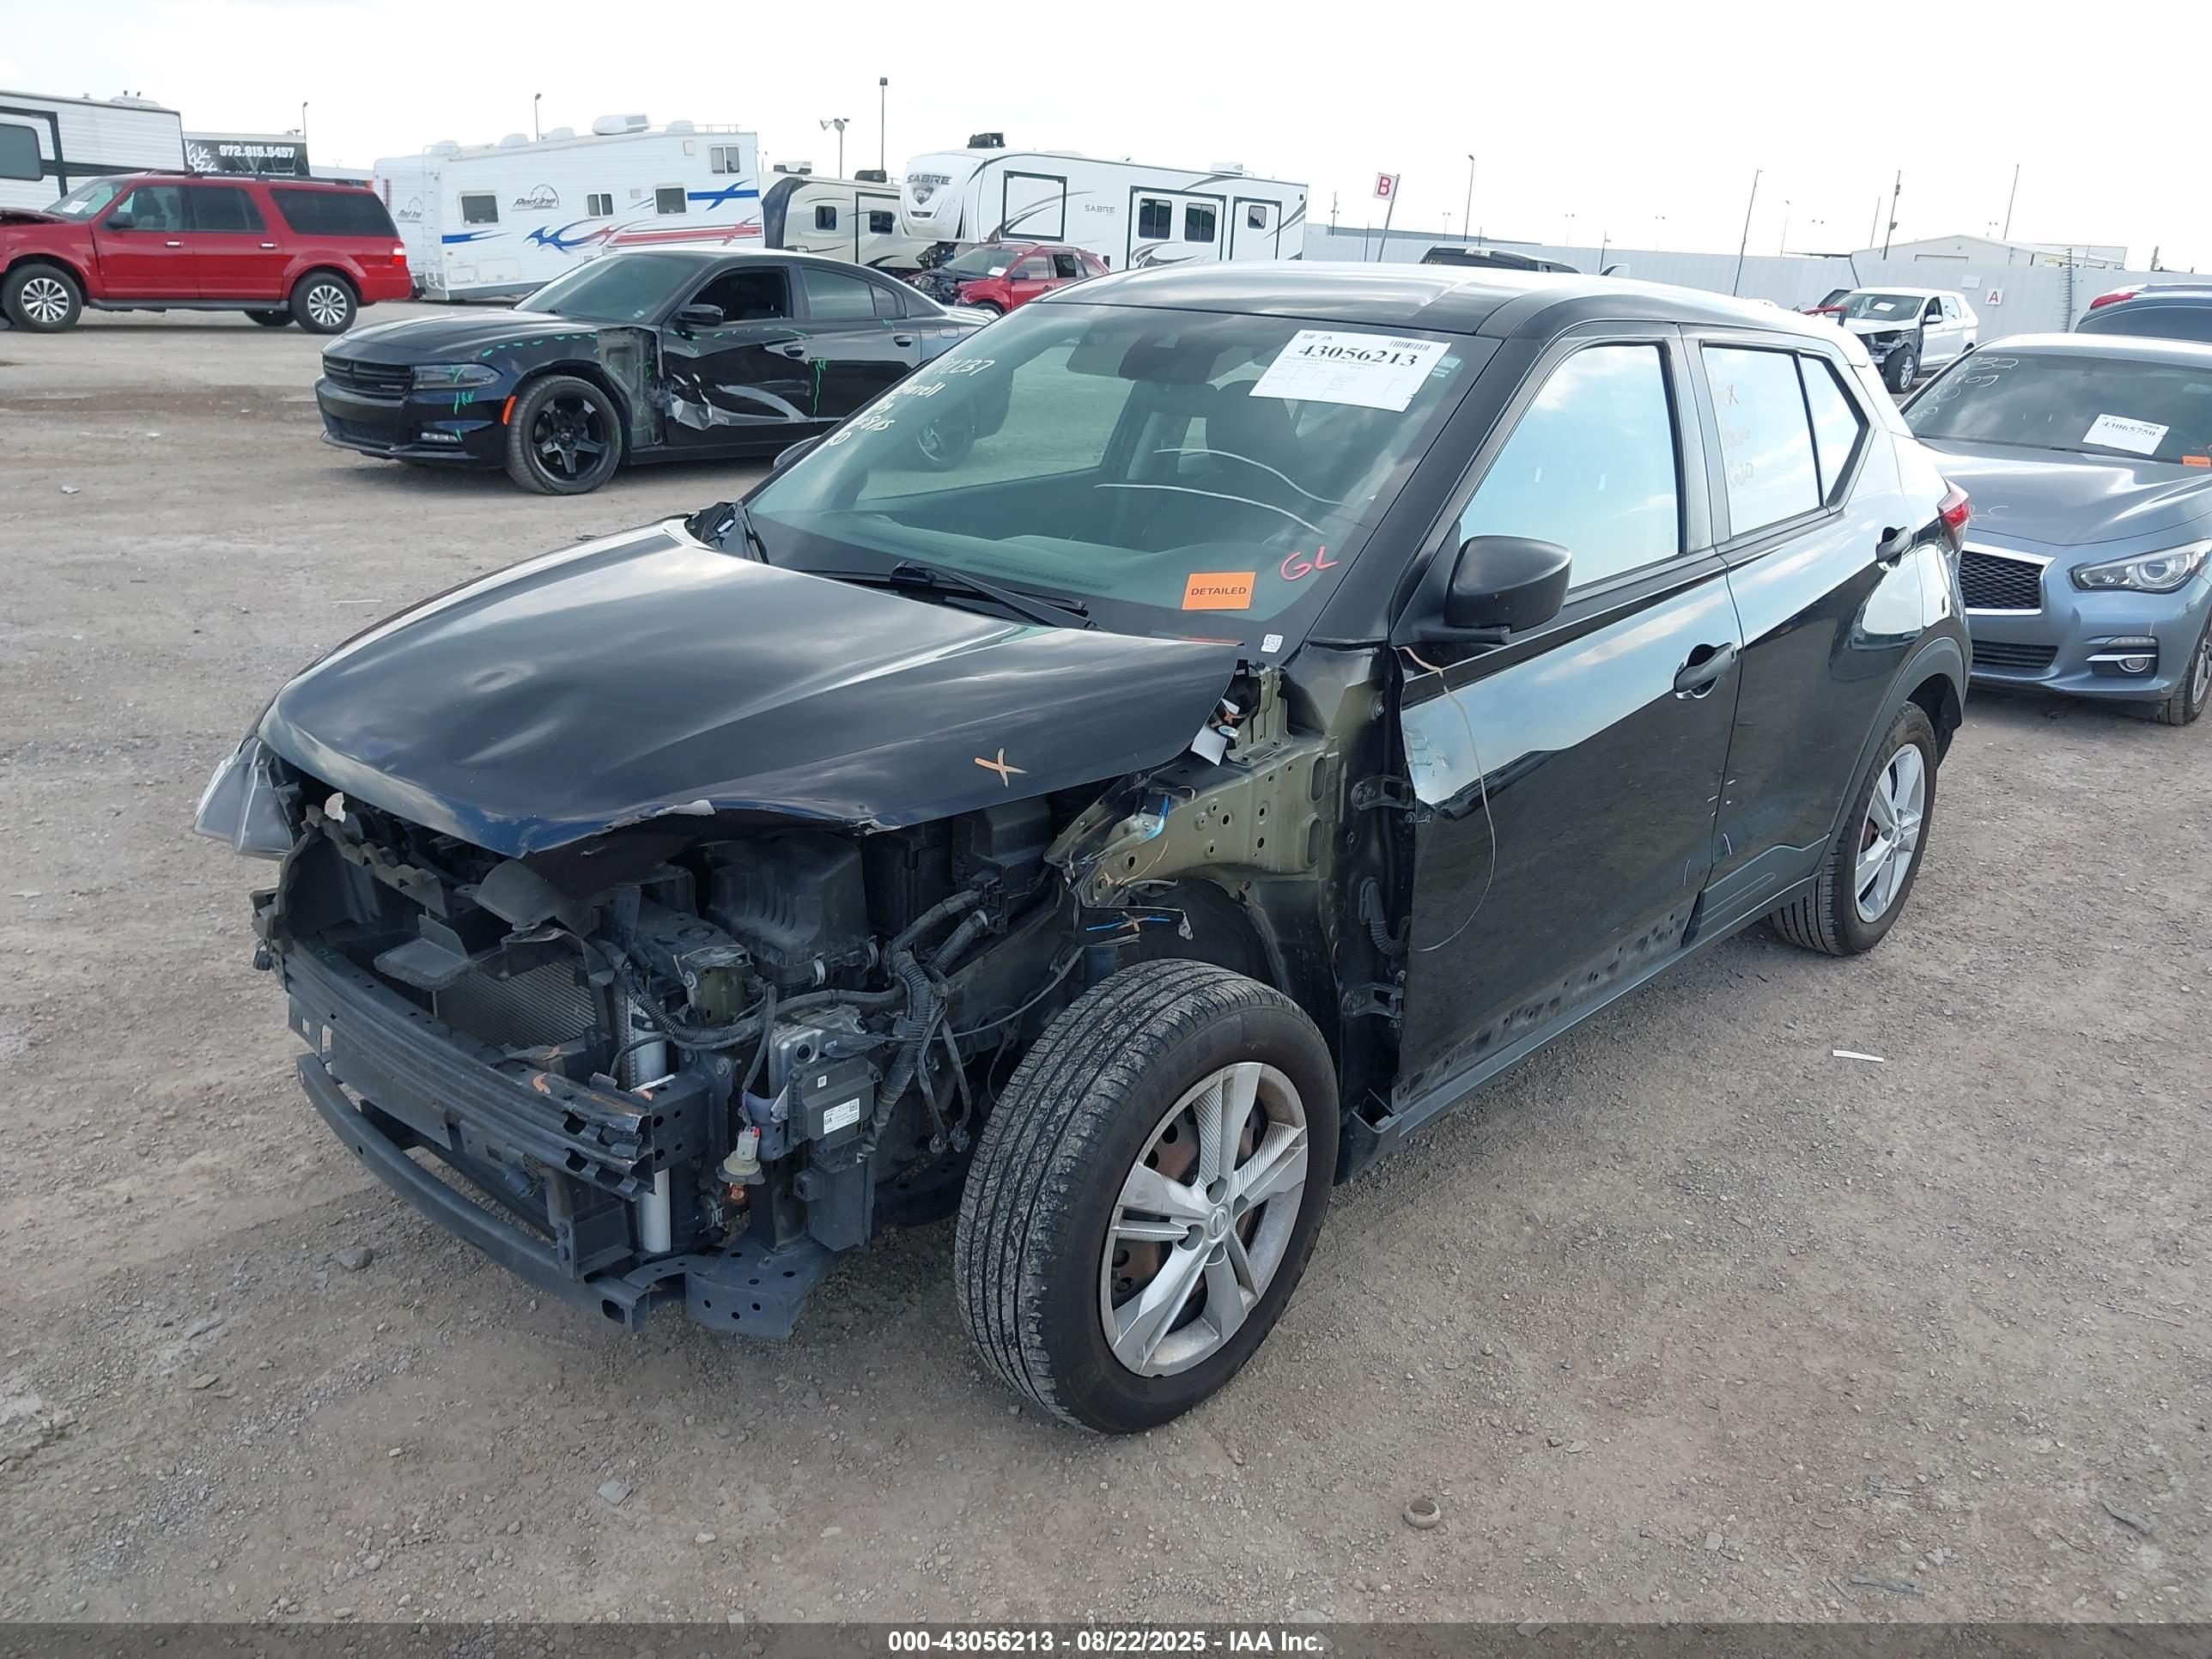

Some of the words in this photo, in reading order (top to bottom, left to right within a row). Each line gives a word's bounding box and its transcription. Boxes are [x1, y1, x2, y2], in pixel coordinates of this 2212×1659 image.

[906, 173, 953, 185] SABRE
[1376, 175, 1391, 197] B
[1085, 204, 1116, 214] SABRE
[1988, 290, 1999, 303] A
[1297, 343, 1419, 368] 43056213
[1280, 545, 1340, 581] GL
[1191, 586, 1247, 596] DETAILED
